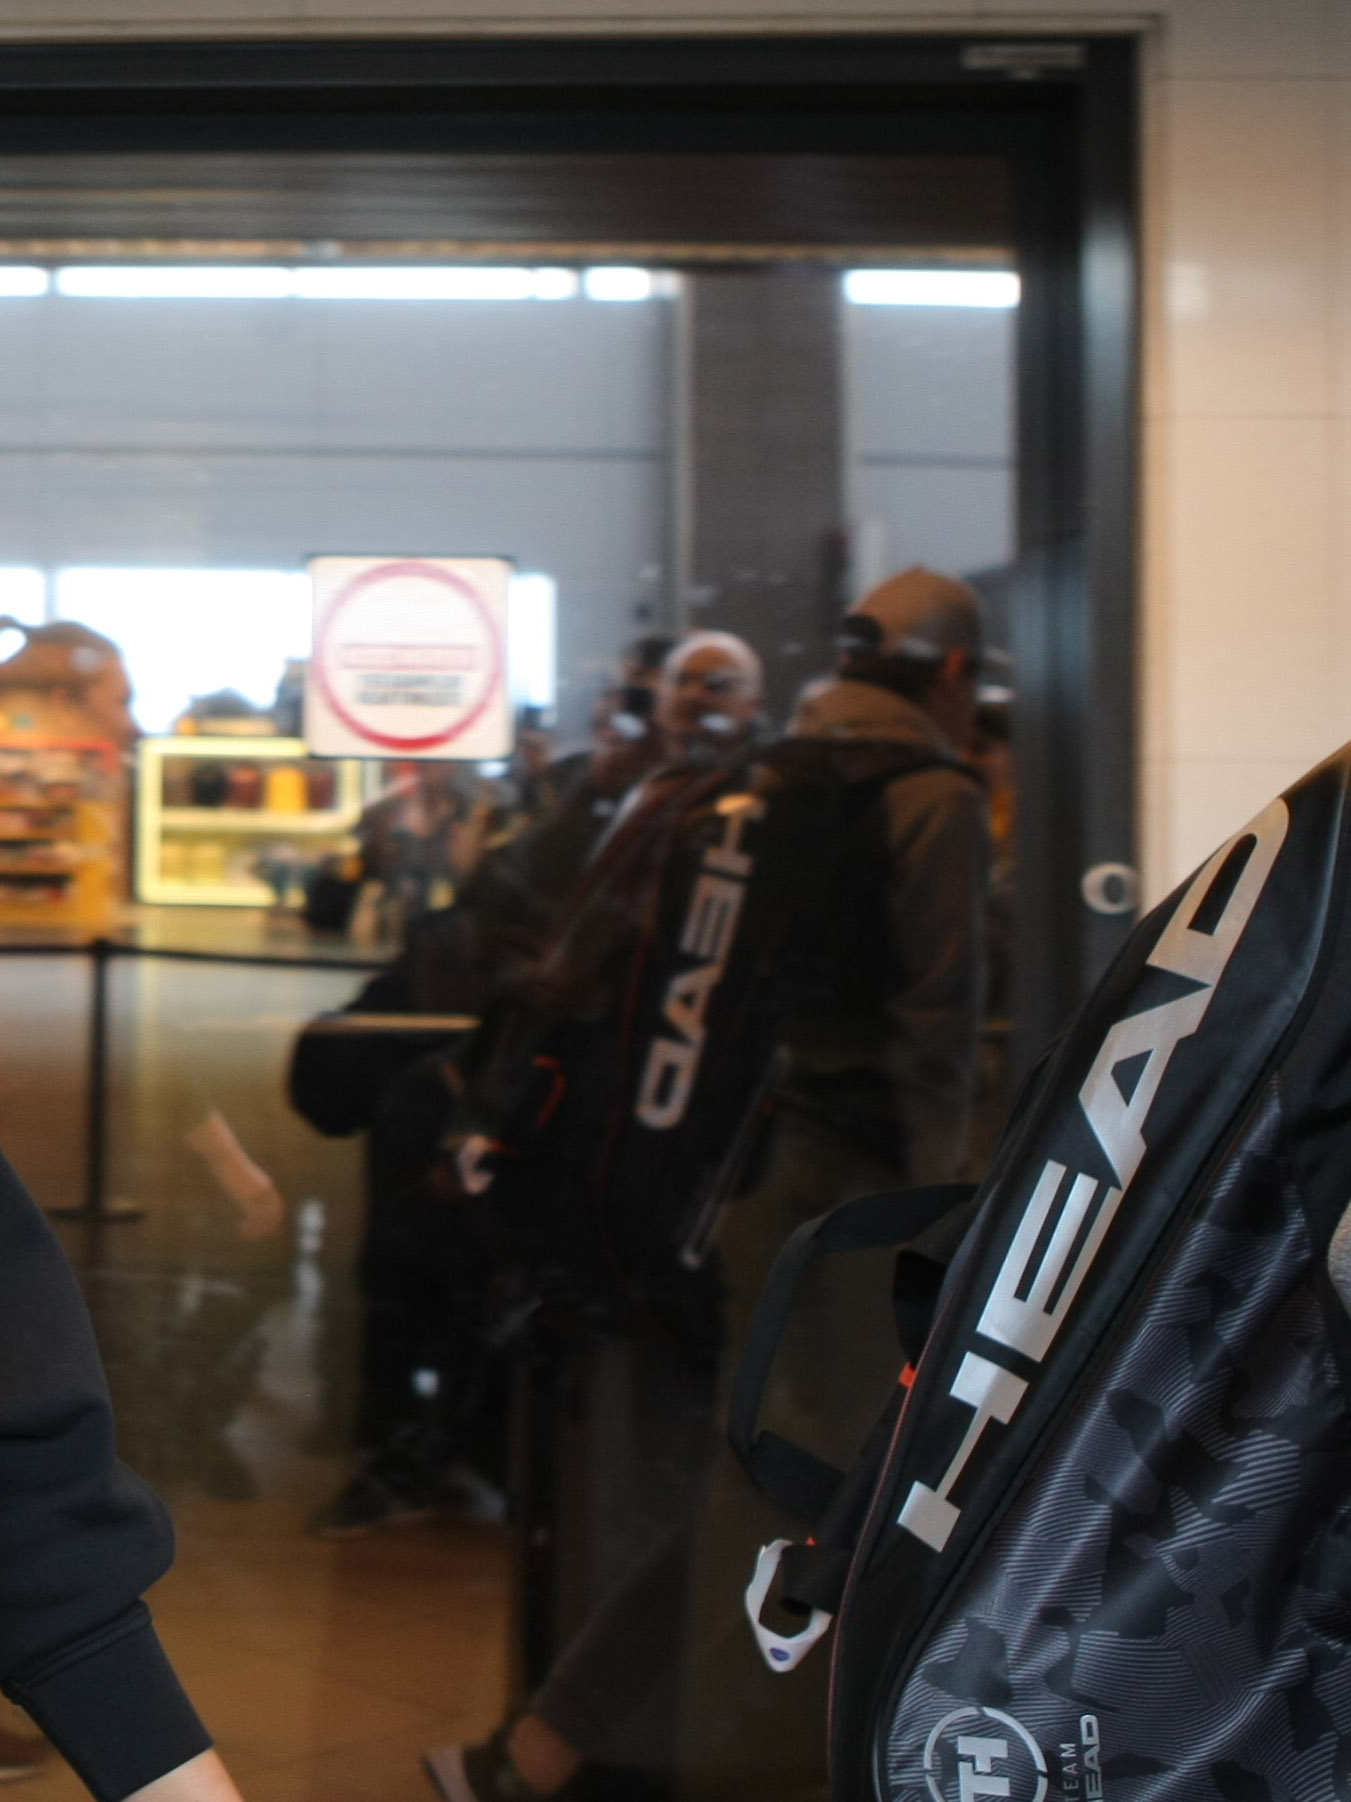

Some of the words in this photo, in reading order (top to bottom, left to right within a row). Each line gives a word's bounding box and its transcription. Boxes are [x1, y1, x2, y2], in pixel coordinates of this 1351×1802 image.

[897, 797, 1289, 1552] HEAD
[1059, 1743, 1080, 1802] TEAM
[1080, 1714, 1104, 1802] EAD
